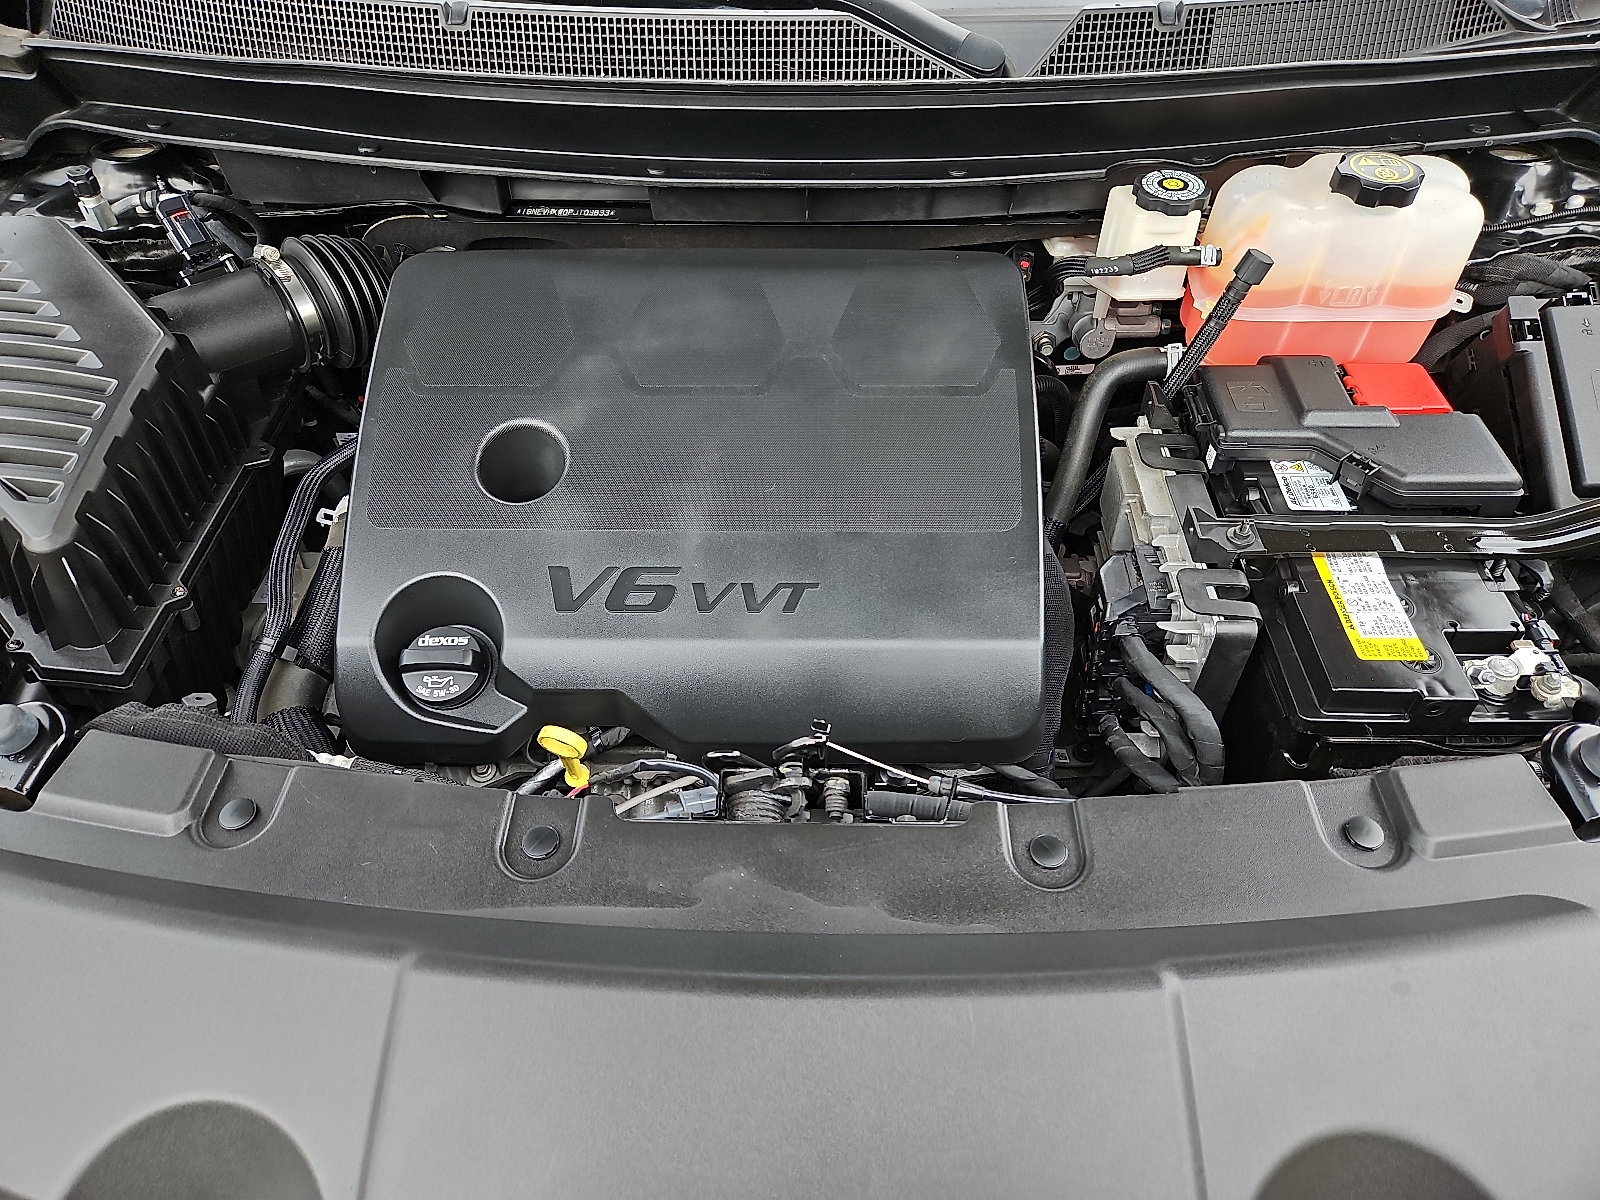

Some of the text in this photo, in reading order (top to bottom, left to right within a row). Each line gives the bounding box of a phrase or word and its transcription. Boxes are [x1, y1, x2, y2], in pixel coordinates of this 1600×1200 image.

[548, 566, 820, 613] V6 VVT
[417, 634, 471, 647] dexos
[416, 684, 460, 698] SAE 5W-30
